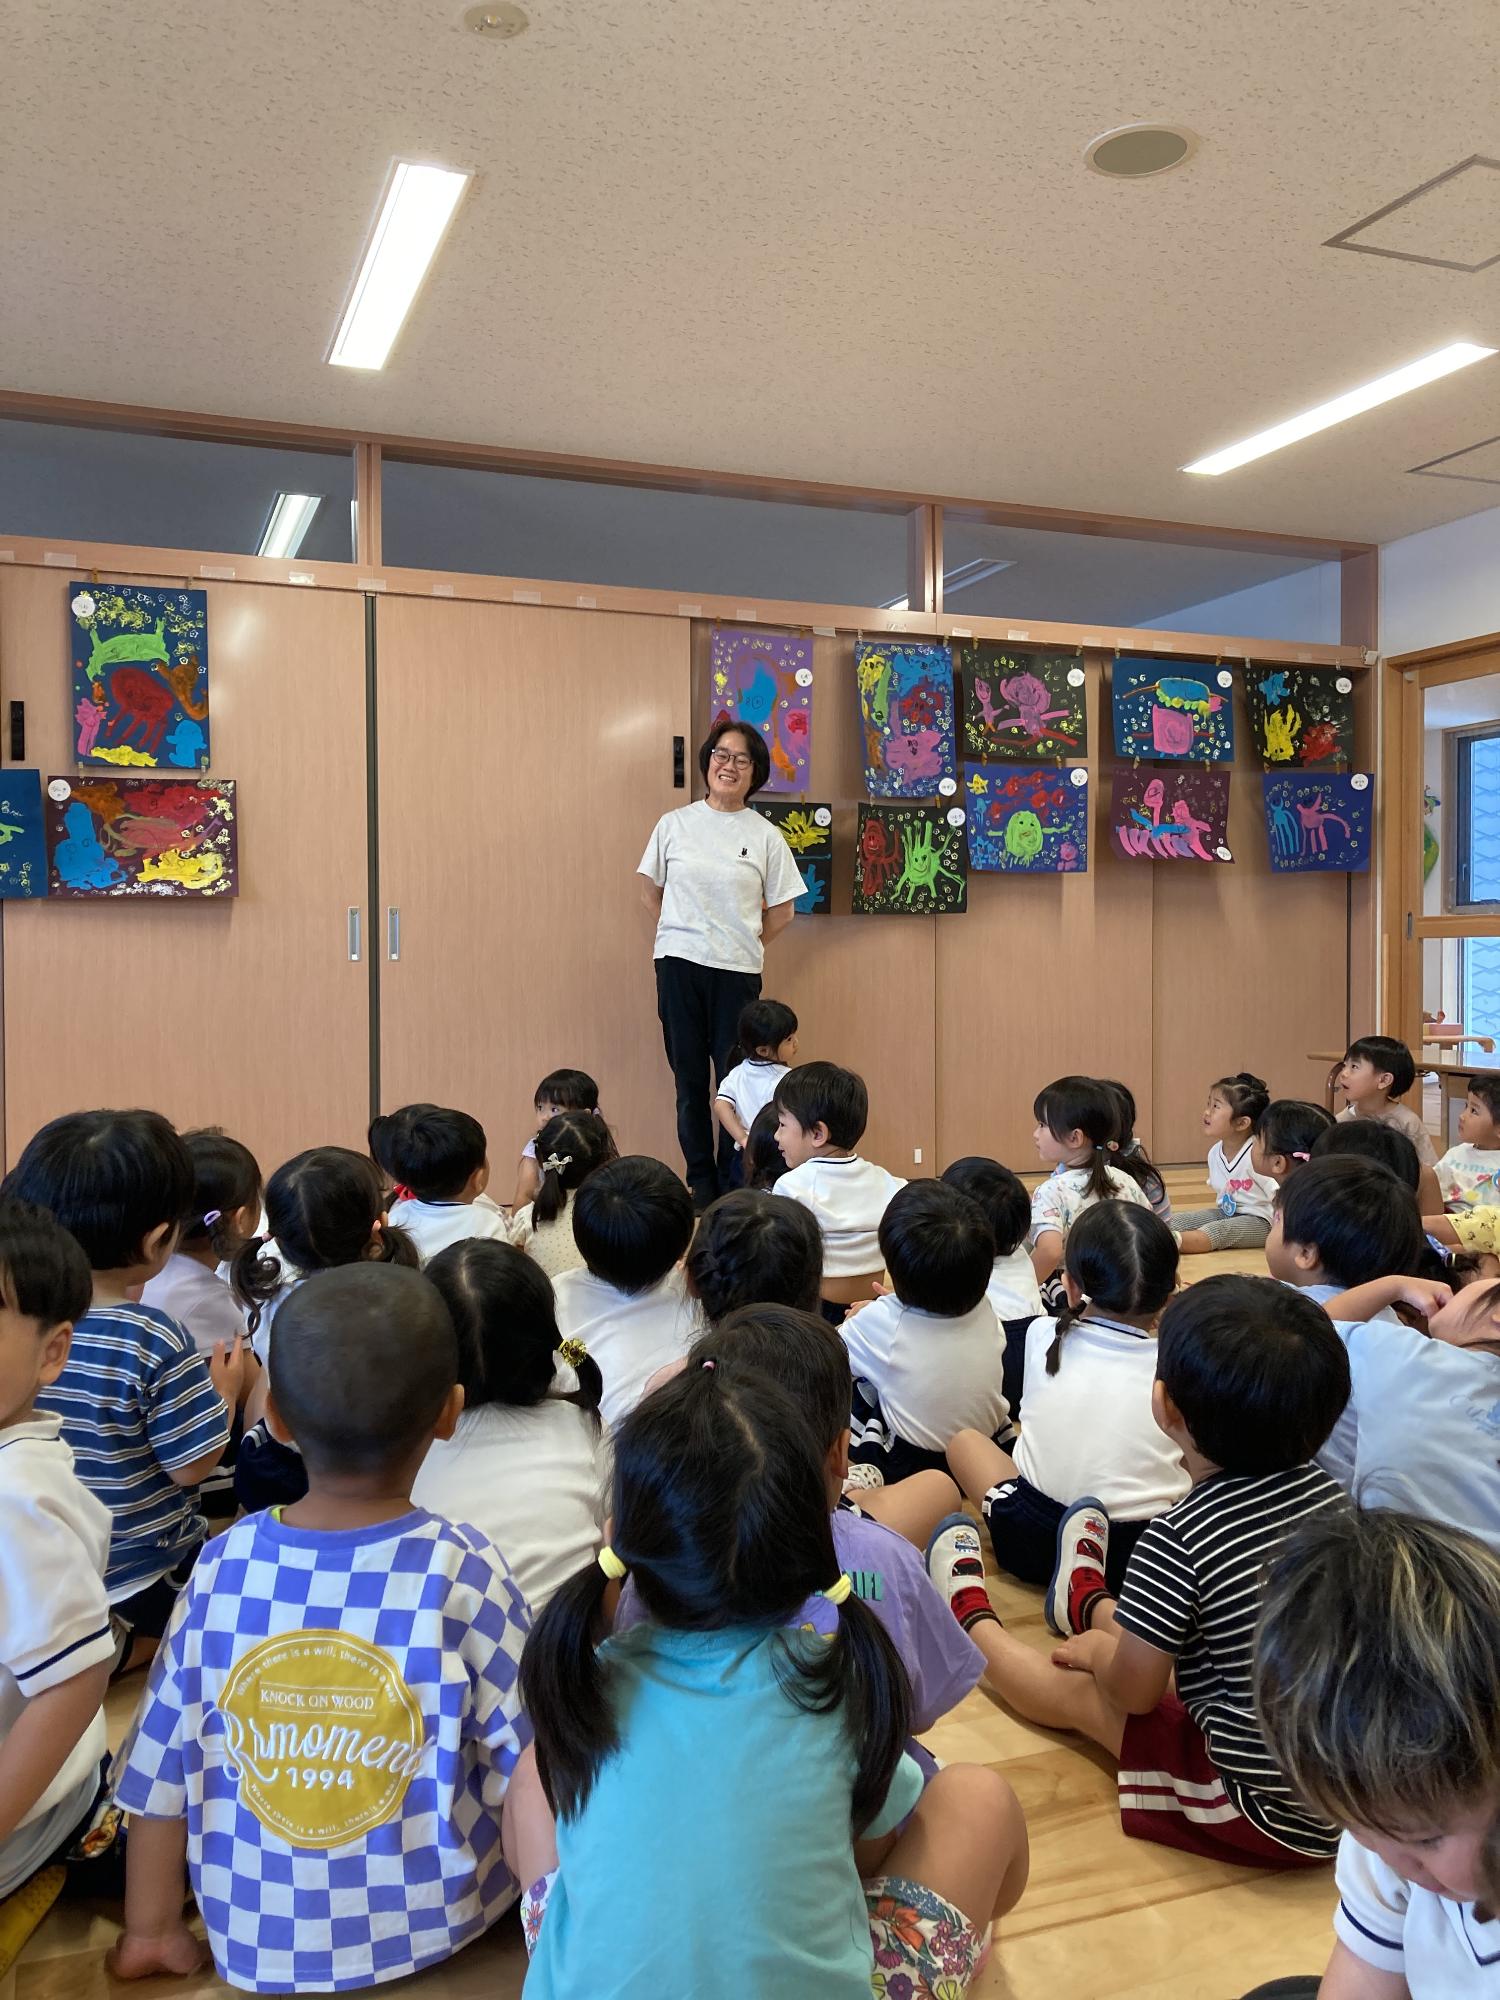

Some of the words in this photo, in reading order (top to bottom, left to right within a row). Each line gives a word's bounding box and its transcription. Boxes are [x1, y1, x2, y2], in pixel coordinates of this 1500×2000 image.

[260, 1689, 305, 1708] KNOCK
[308, 1694, 329, 1708] ON
[331, 1695, 374, 1710] WOOD
[286, 1767, 355, 1790] 1994
